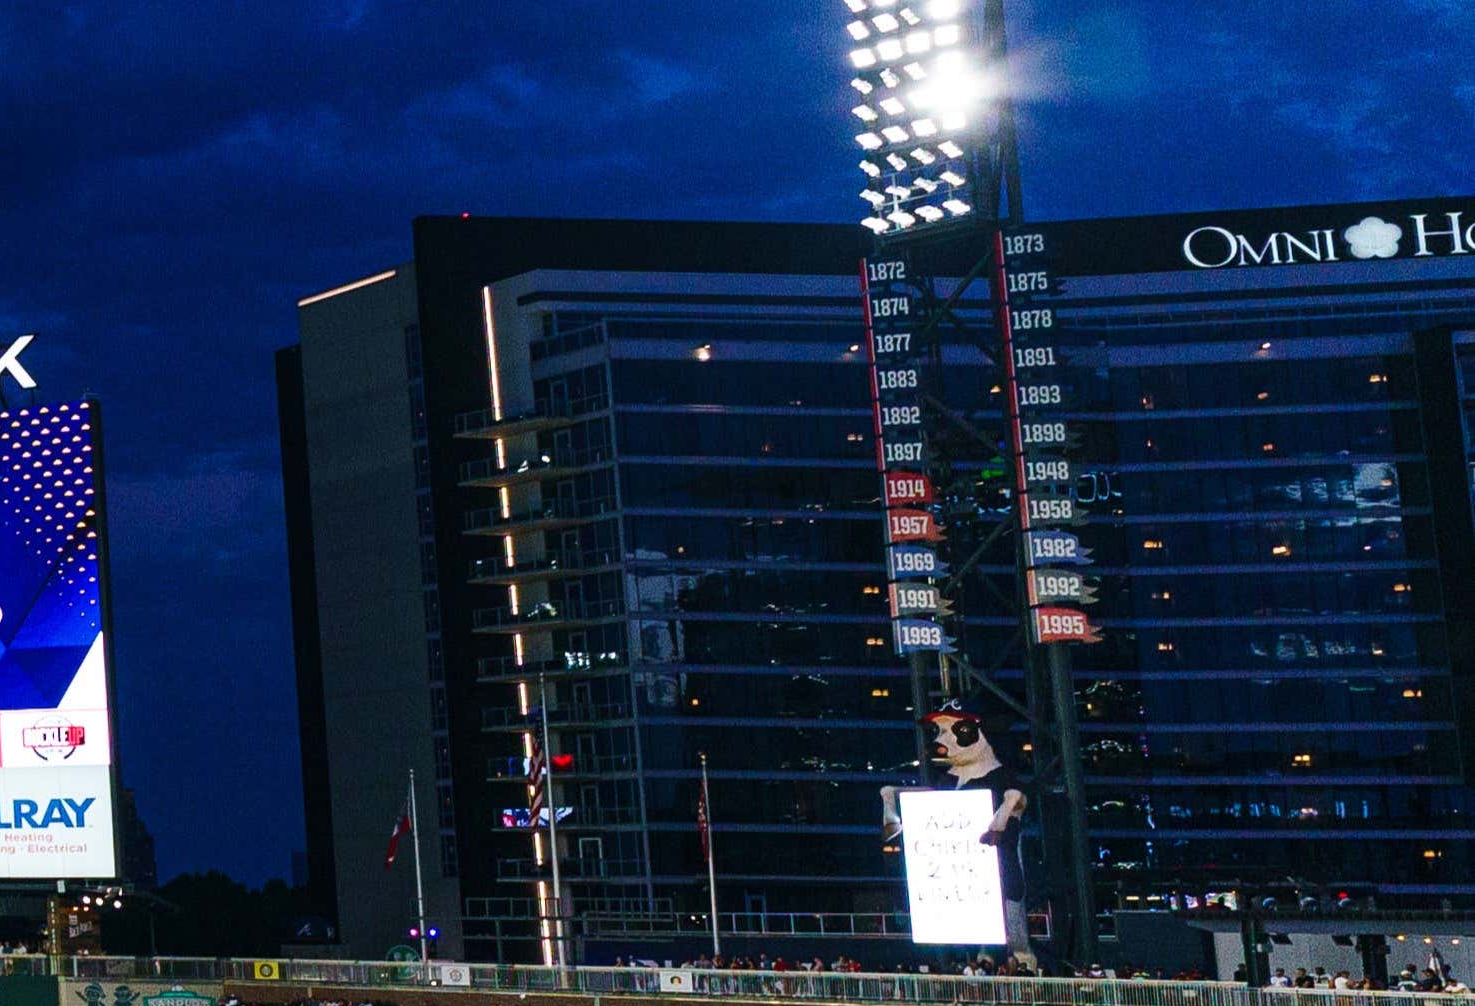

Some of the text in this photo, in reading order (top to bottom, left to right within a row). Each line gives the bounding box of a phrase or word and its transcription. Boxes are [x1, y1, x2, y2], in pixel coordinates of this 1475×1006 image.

[1005, 234, 1044, 255] 1873
[1183, 226, 1339, 268] OMNI
[869, 261, 905, 281] 1872
[1009, 272, 1048, 292] 1875
[872, 297, 909, 317] 1874
[1012, 310, 1052, 330] 1878
[876, 333, 911, 353] 1877
[1016, 347, 1056, 367] 1891
[879, 370, 917, 389] 1883
[1020, 385, 1061, 405] 1893
[882, 406, 921, 426] 1892
[1023, 423, 1065, 443] 1898
[886, 443, 923, 462] 1897
[1027, 461, 1069, 481] 1948
[889, 479, 925, 498] 1914
[1030, 500, 1072, 519] 1958
[892, 516, 928, 534] 1957
[1033, 538, 1076, 558] 1982
[895, 553, 935, 572] 1969
[1037, 577, 1080, 596] 1992
[898, 590, 937, 608] 1991
[1041, 615, 1084, 634] 1995
[902, 626, 941, 645] 1993
[4, 831, 53, 843] Heating
[27, 843, 88, 853] Electrical
